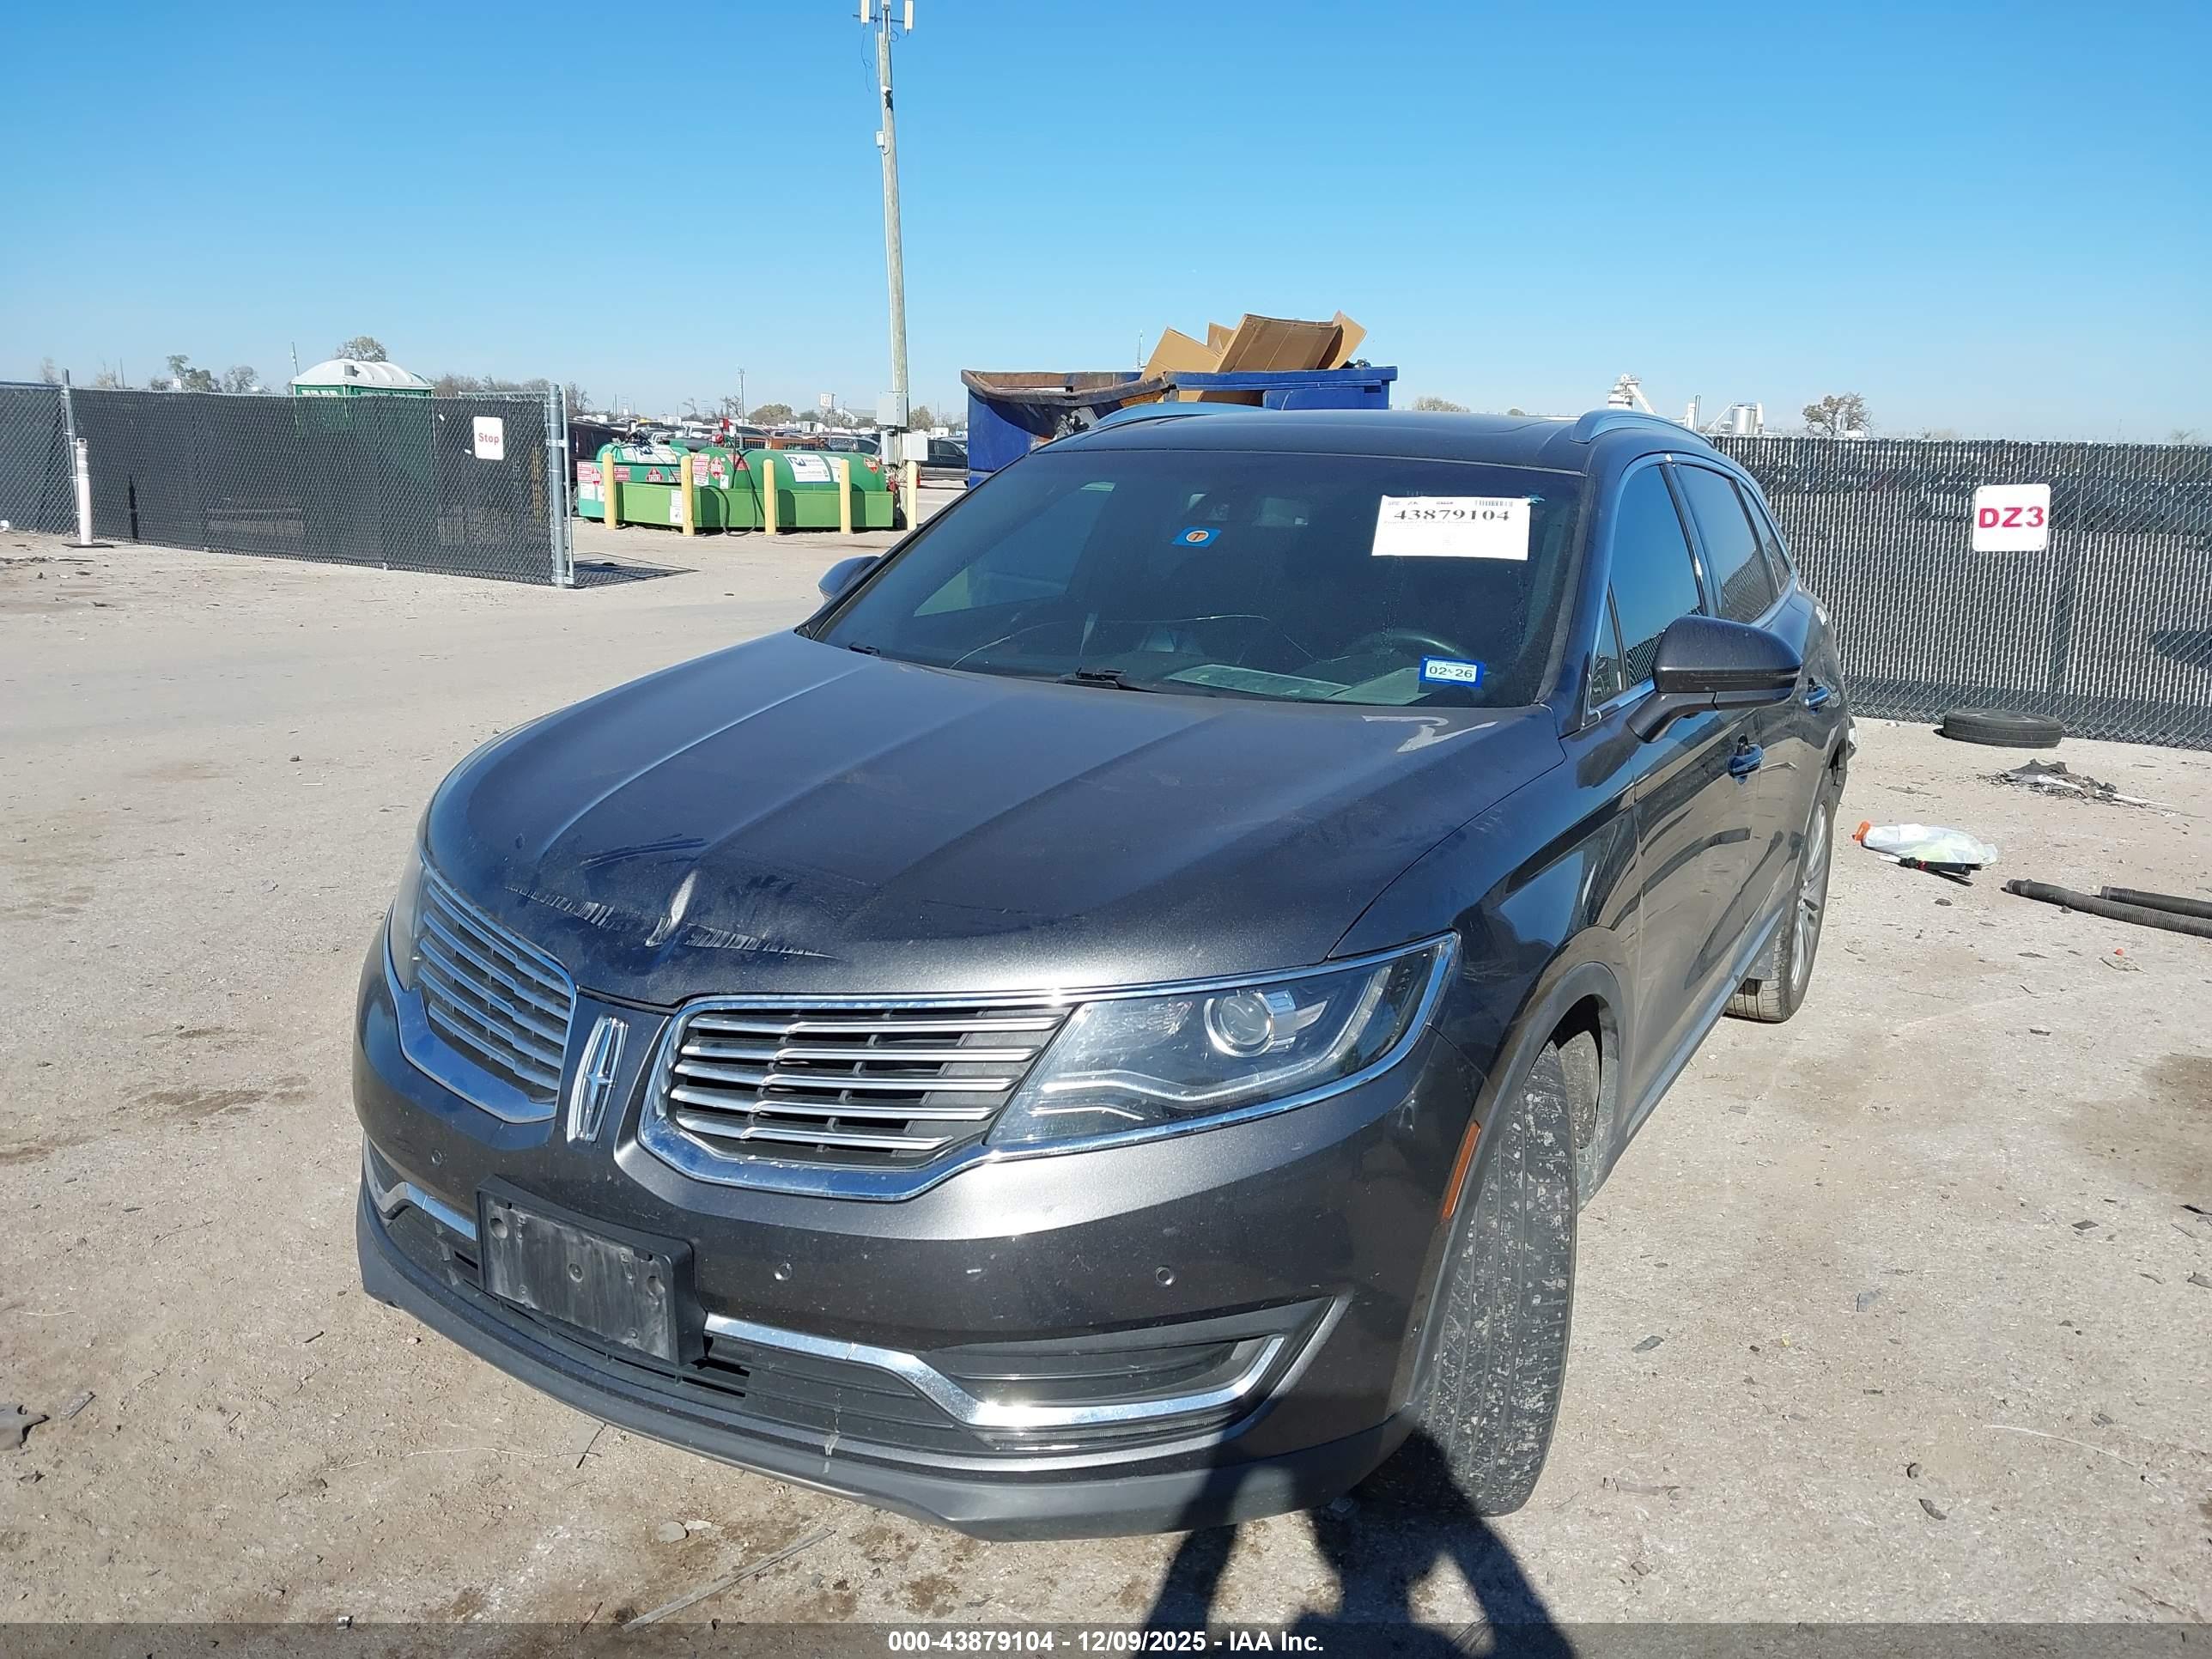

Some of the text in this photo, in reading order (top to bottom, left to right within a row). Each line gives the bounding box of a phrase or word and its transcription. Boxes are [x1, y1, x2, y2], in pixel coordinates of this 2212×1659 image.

[478, 432, 500, 446] Stop
[1394, 508, 1510, 521] 43879104
[1978, 506, 2045, 528] DZ3
[1429, 665, 1473, 678] 02 26
